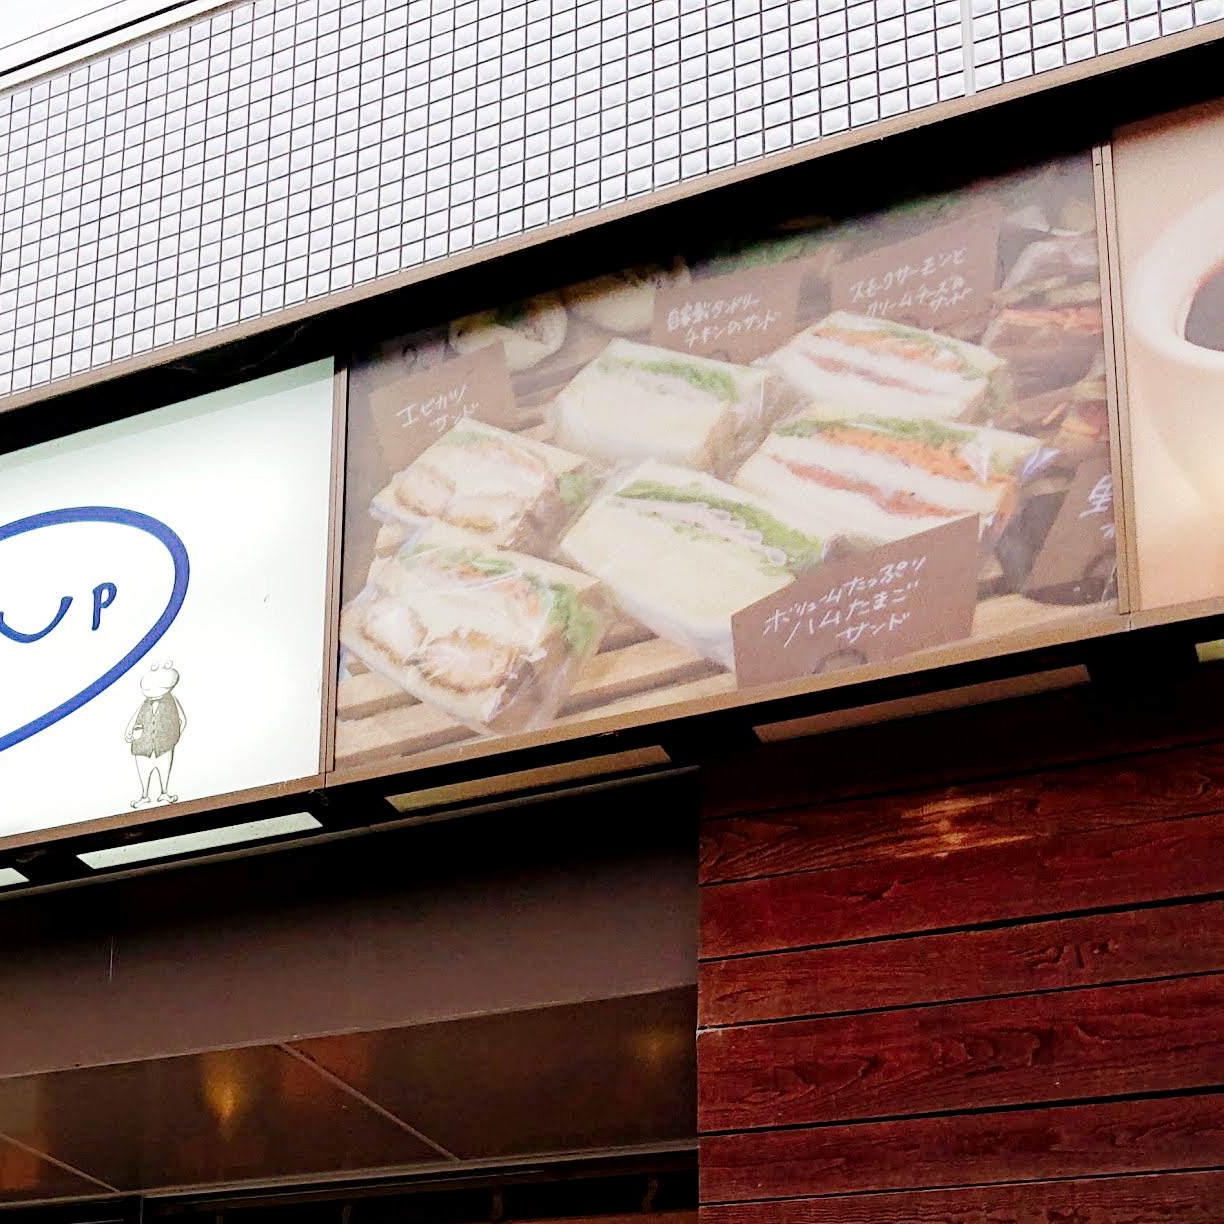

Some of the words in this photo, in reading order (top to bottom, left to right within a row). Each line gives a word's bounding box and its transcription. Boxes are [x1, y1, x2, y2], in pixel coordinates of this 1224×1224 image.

[395, 384, 467, 428] エビカツ
[763, 556, 927, 636] ボリュームたっぷり
[784, 580, 920, 648] ハムたまご
[835, 611, 912, 644] サンド
